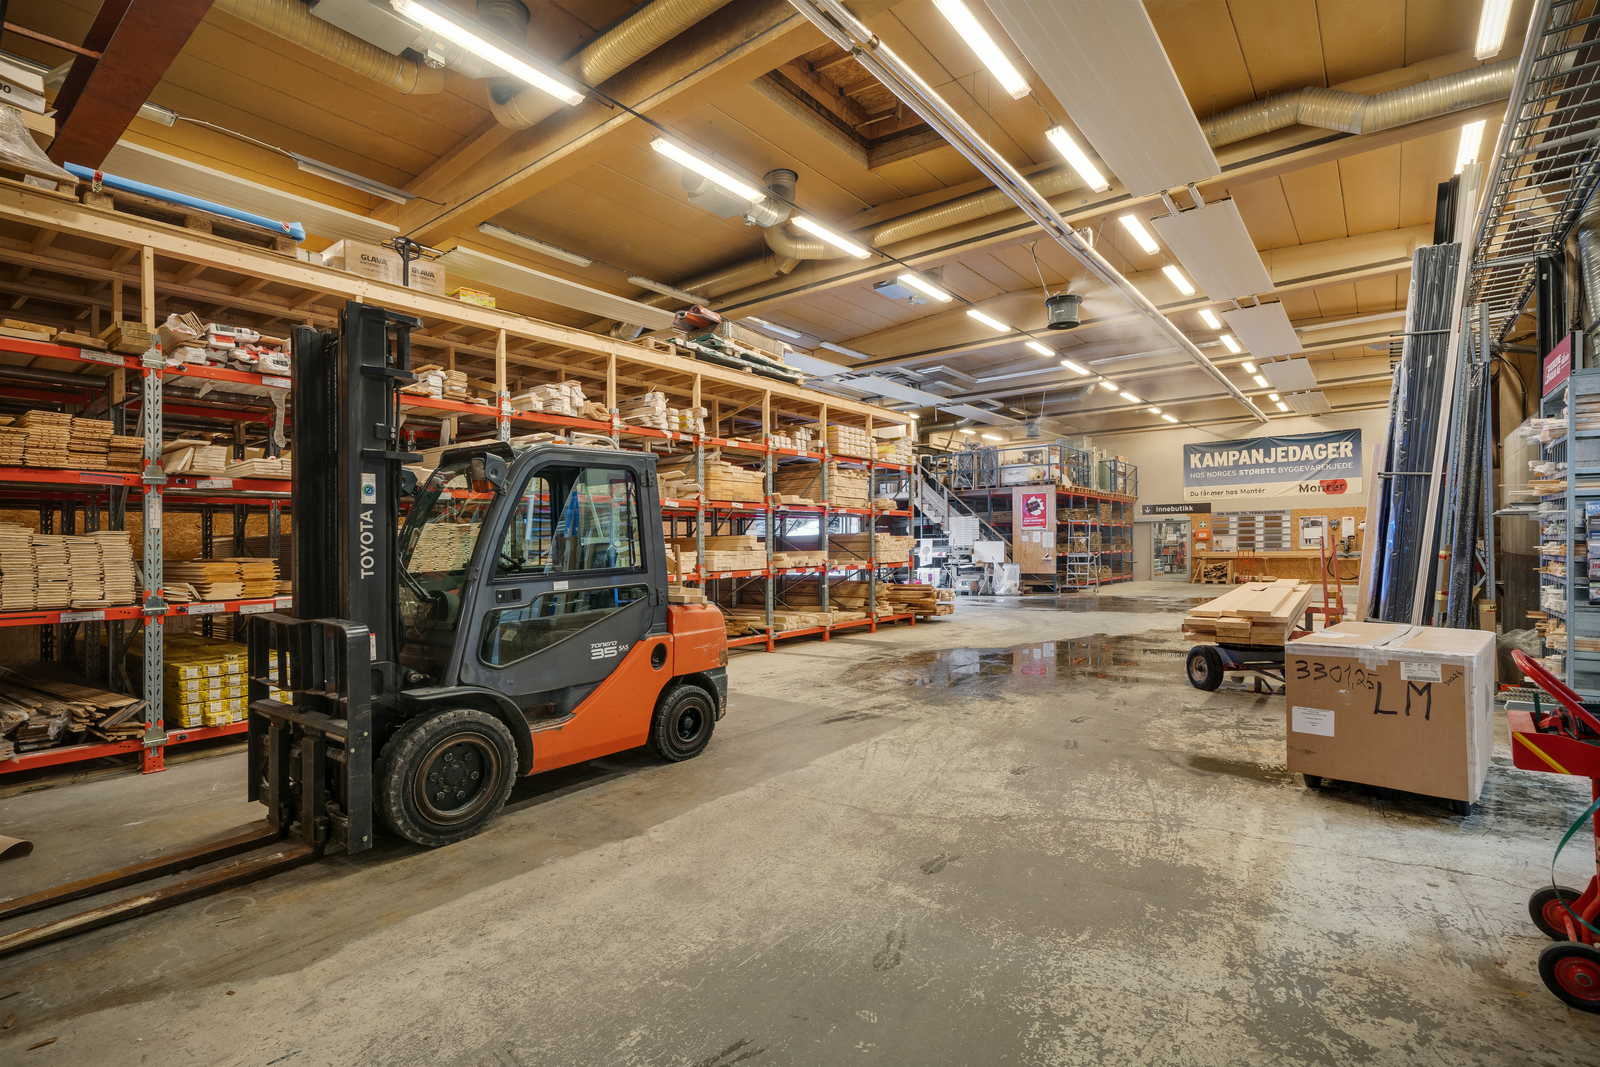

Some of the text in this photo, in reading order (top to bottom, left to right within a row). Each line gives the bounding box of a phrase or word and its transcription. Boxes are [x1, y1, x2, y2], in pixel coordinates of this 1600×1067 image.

[360, 254, 387, 265] GLAVA
[1190, 441, 1353, 468] KAMPANJEDAGER
[1239, 467, 1276, 475] STØRSTE
[1278, 462, 1353, 473] BYGGEVAREKJEDE
[1298, 482, 1345, 493] Montér
[360, 510, 374, 579] TOYOTA
[591, 646, 617, 660] 35
